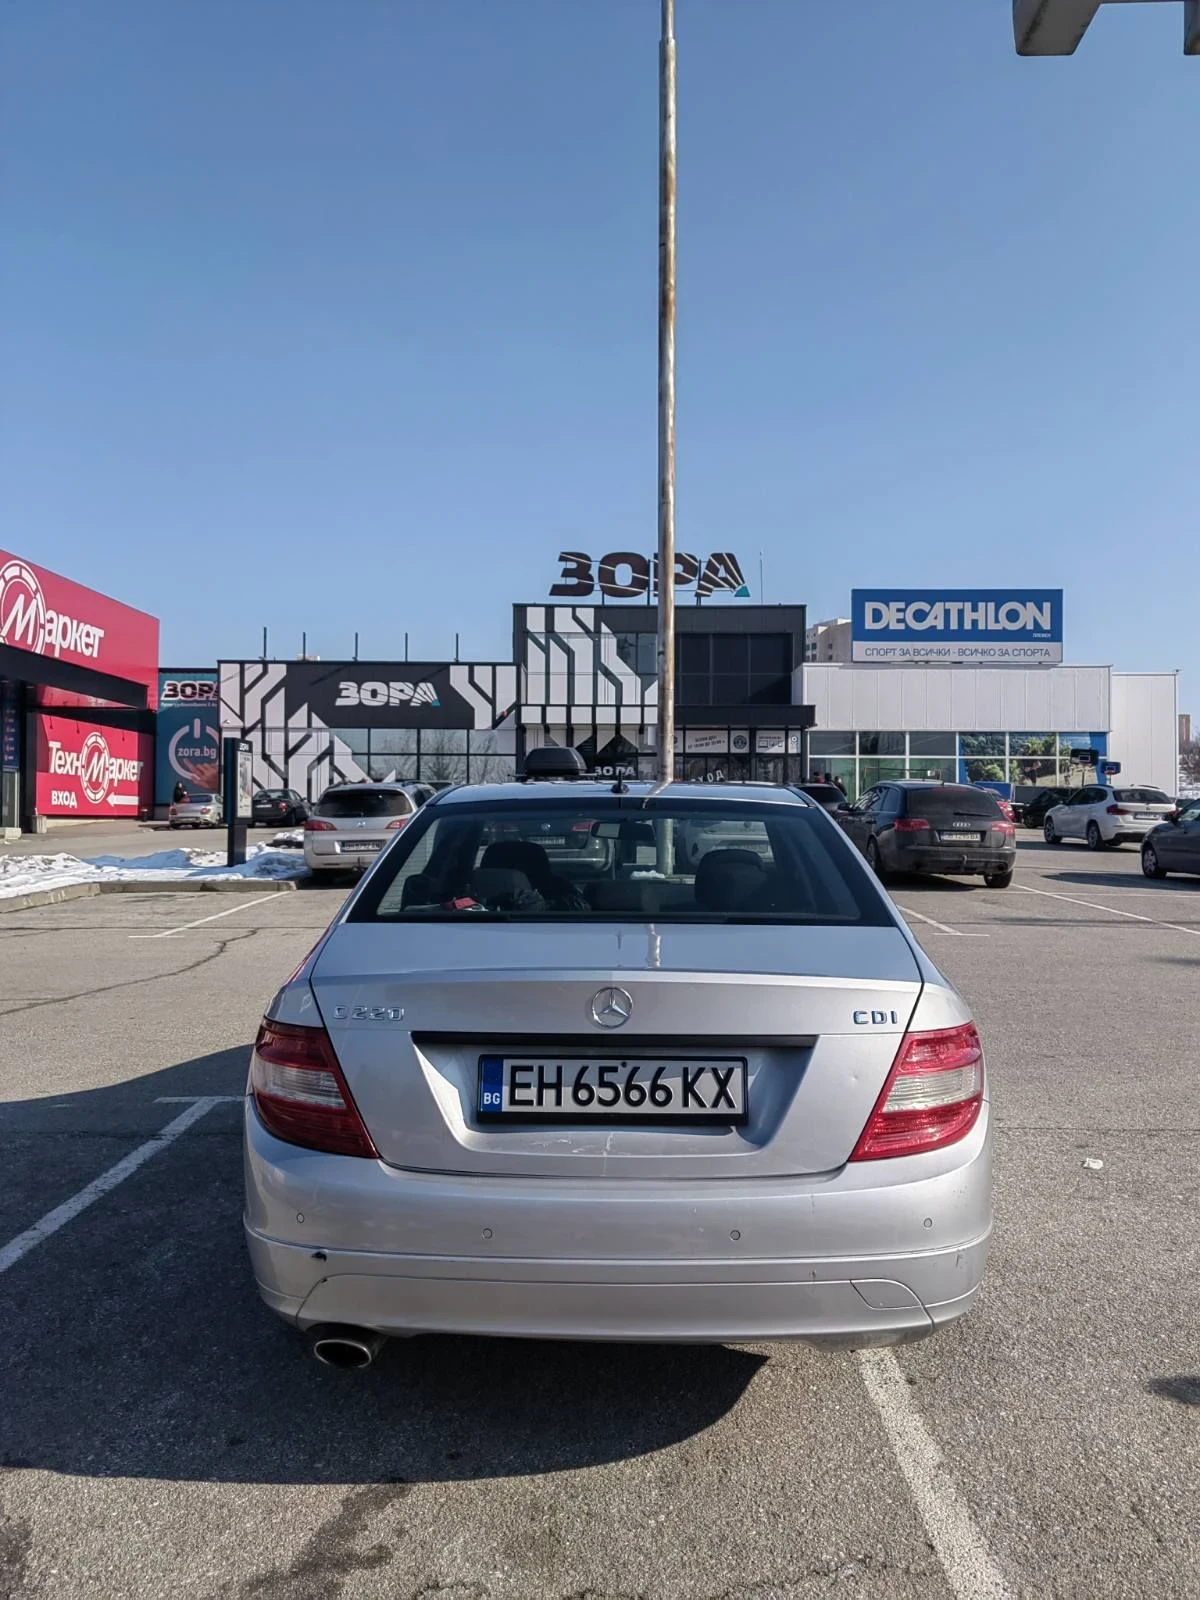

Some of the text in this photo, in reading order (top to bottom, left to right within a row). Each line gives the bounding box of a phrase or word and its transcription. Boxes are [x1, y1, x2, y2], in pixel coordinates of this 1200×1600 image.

[549, 552, 750, 597] ЗОРА
[864, 601, 1051, 630] DECATHLON
[864, 648, 898, 658] СПОРТ
[899, 648, 911, 658] ЗА
[913, 648, 950, 657] ВСИЧКИ
[958, 648, 995, 657] ВСИЧКО
[997, 648, 1011, 657] ЗА
[1012, 648, 1051, 657] СПОРТА
[335, 681, 440, 707] ЗОРА
[177, 745, 217, 759] zora.bg
[51, 790, 77, 808] ВХОД
[853, 1010, 898, 1025] CDI
[483, 1091, 501, 1105] BG
